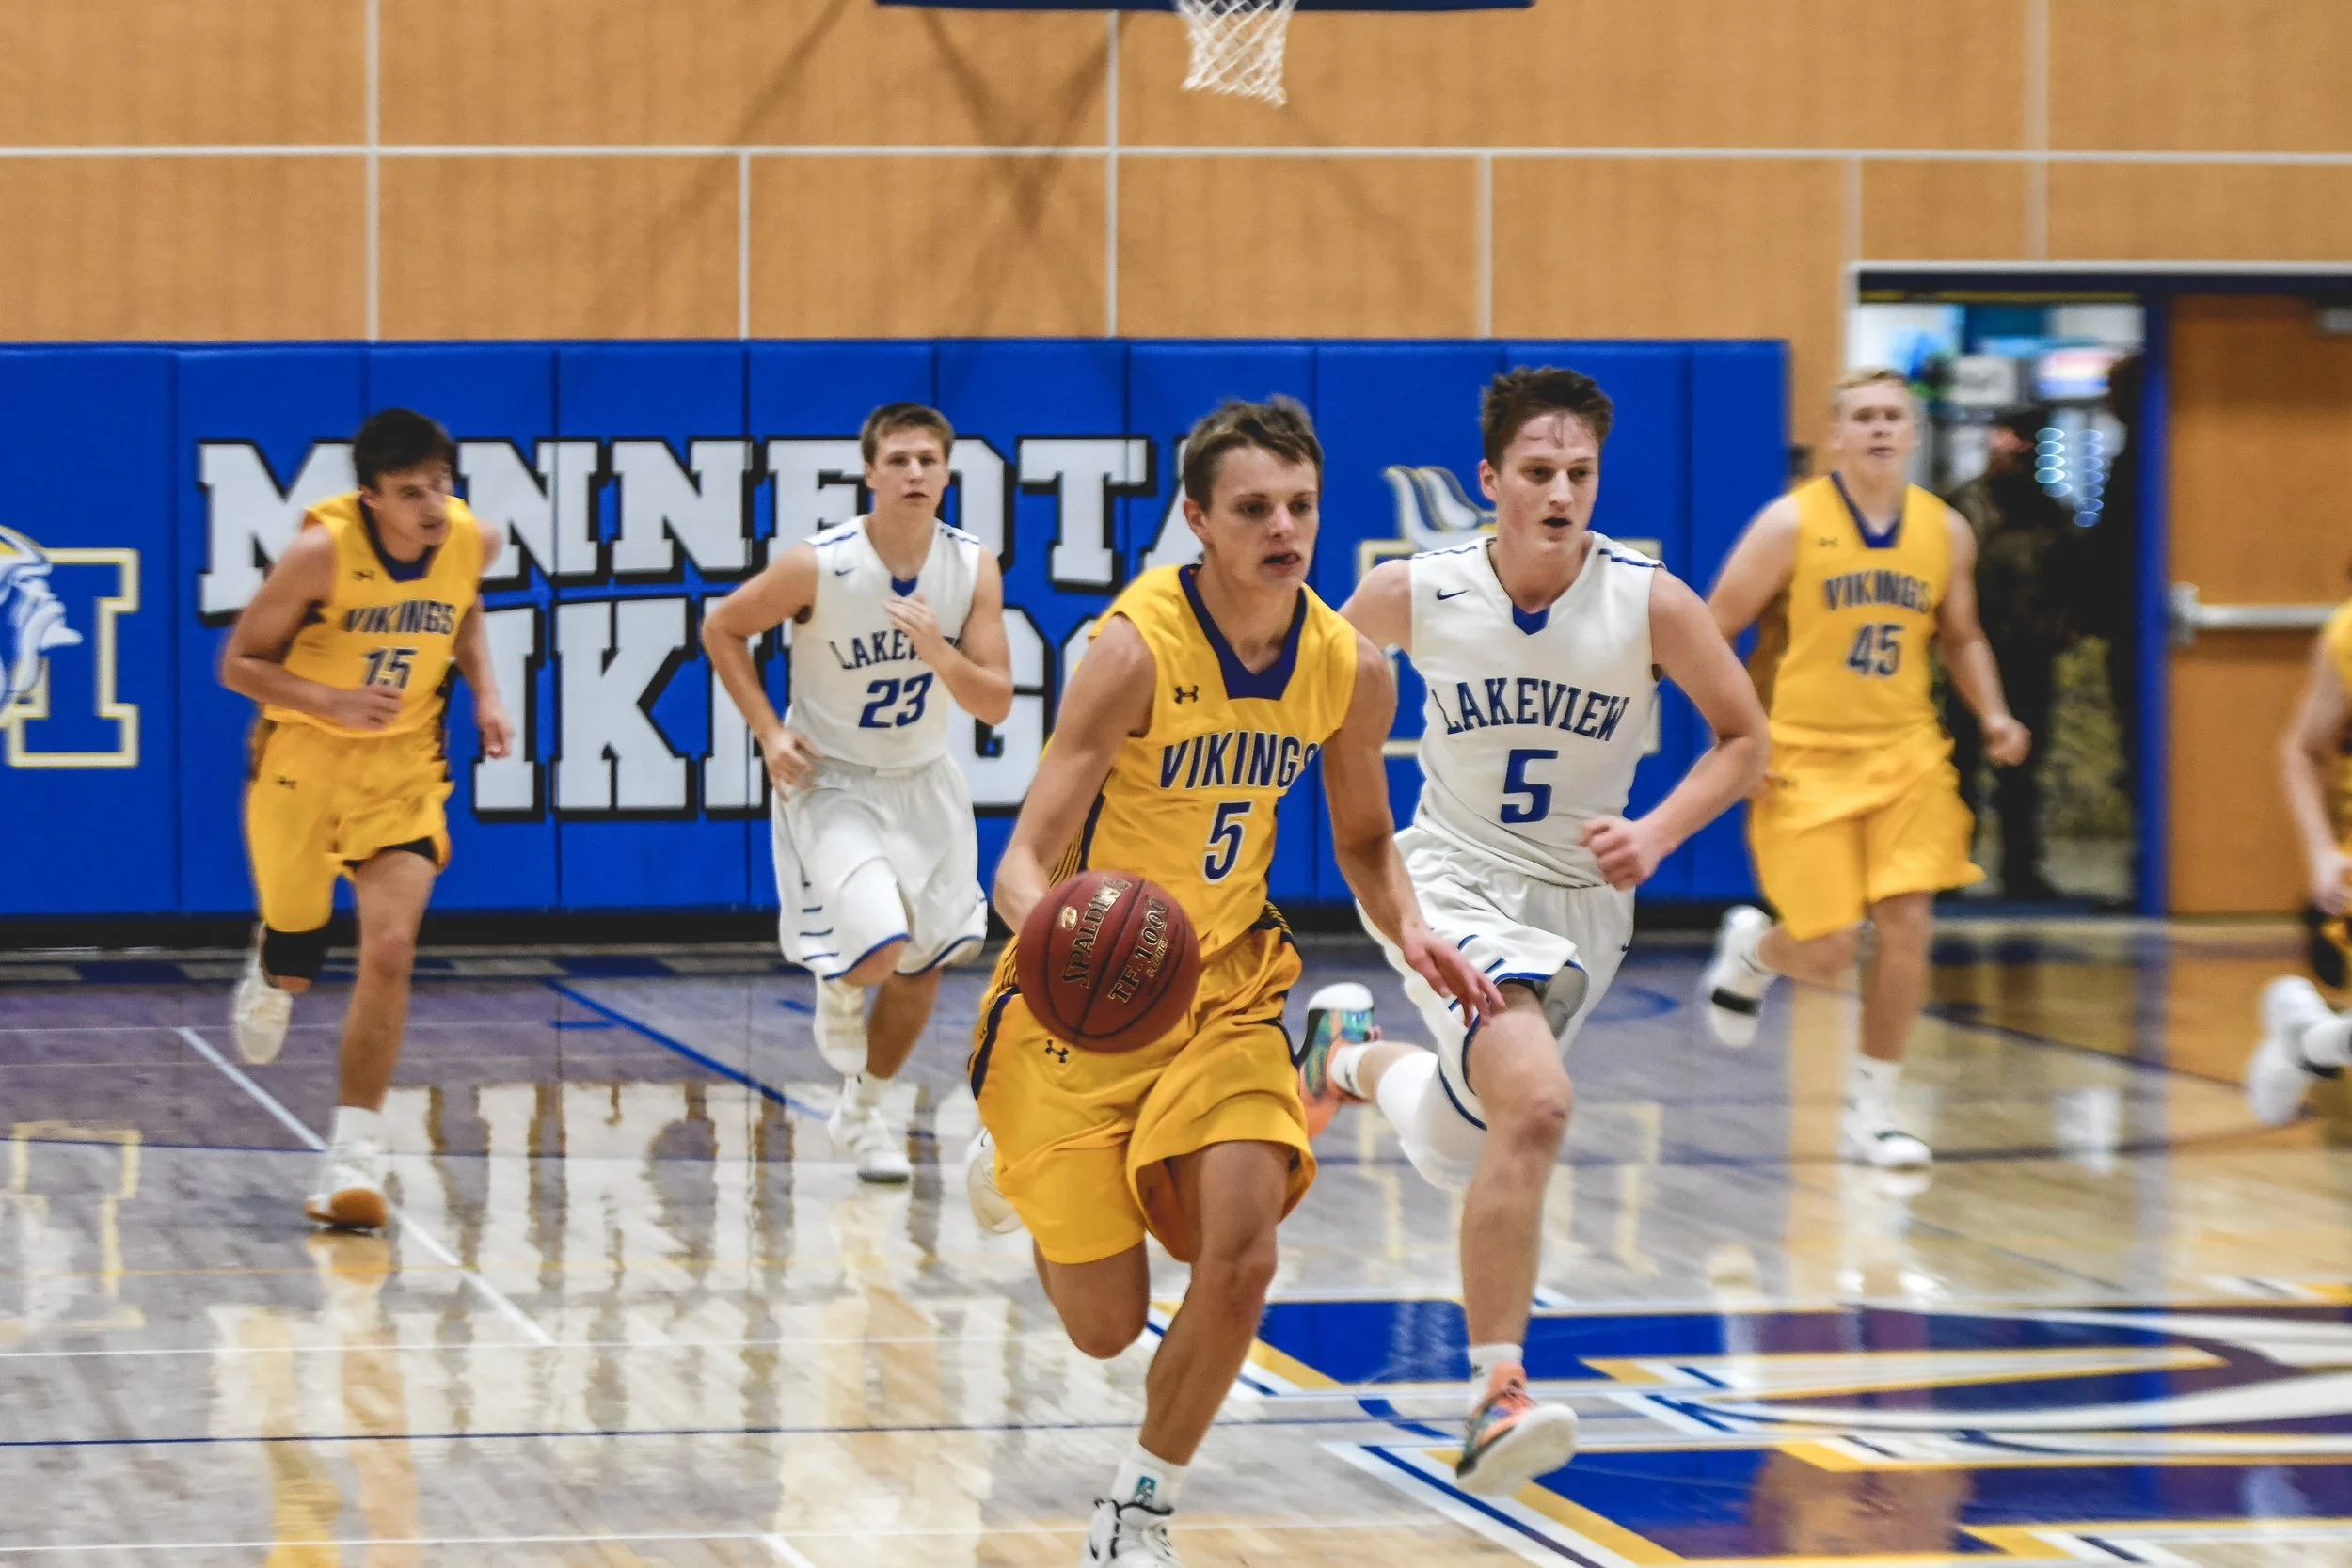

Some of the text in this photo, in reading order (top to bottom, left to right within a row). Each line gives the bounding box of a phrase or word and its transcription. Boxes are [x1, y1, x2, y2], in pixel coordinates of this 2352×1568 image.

[197, 436, 1185, 626] MNNET
[342, 600, 456, 636] VIKINGS
[1821, 569, 1932, 615] VIKINGS
[364, 646, 419, 690] 15
[829, 628, 961, 670] LAKE
[1845, 622, 1905, 677] 45
[858, 671, 934, 728] 23
[1431, 677, 1630, 742] LAKEVIEW
[1500, 749, 1559, 824] 5
[1202, 800, 1253, 883] 5
